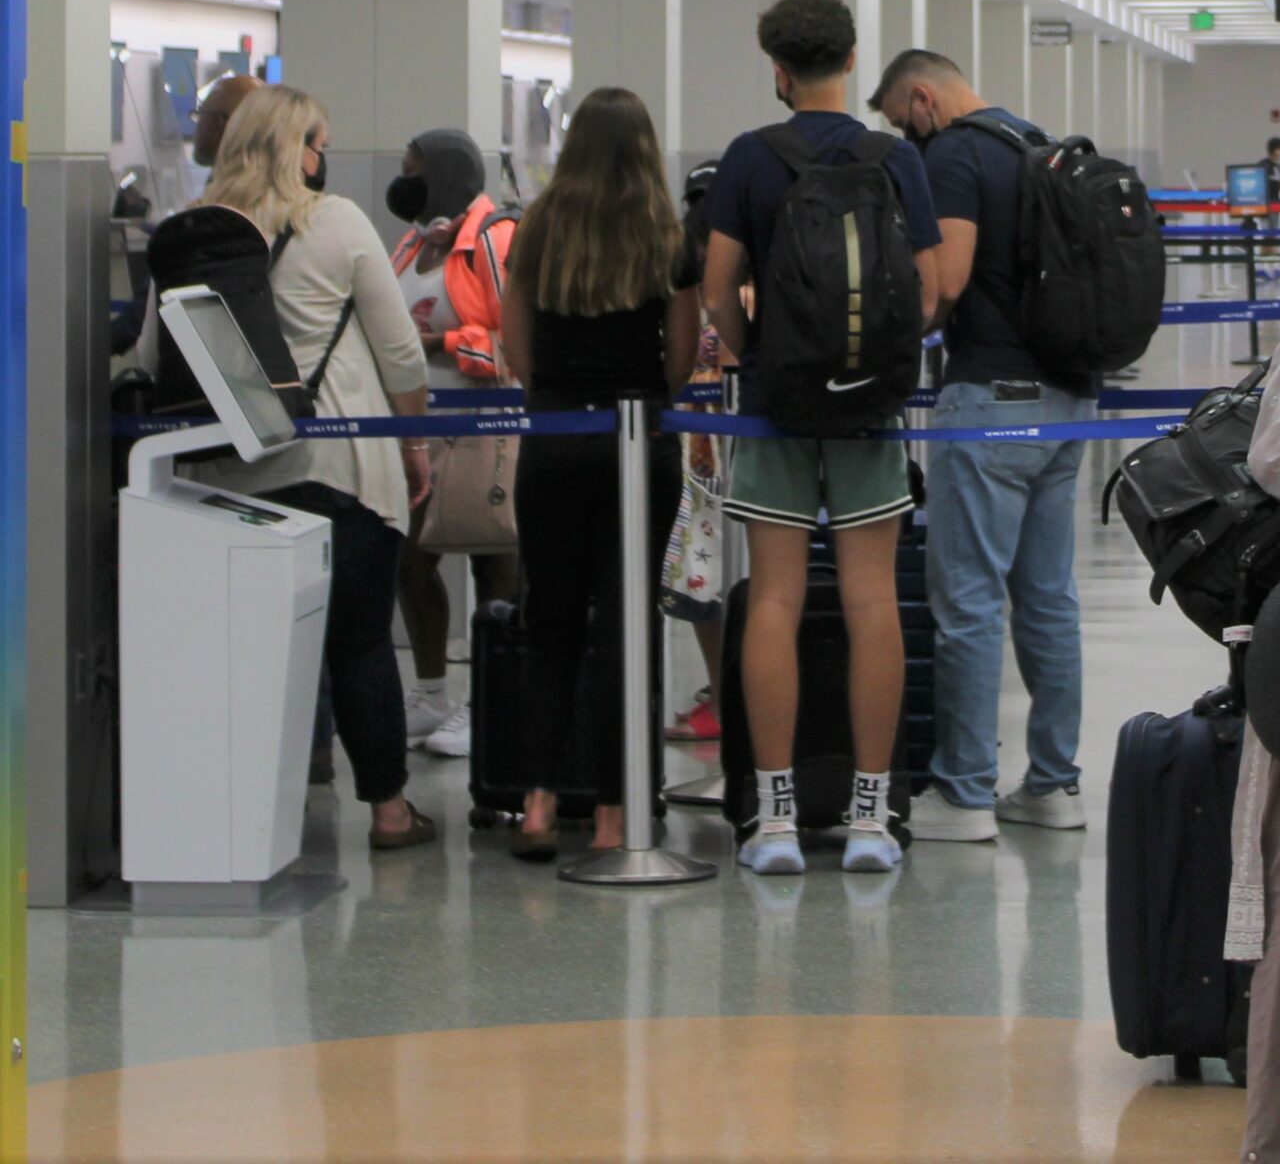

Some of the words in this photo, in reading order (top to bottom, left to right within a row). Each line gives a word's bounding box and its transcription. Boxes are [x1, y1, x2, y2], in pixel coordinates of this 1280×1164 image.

[692, 388, 722, 397] UNITE
[907, 393, 936, 402] ITED
[305, 424, 347, 433] UNITED
[477, 420, 518, 429] UNITED
[1155, 423, 1184, 432] UNIT
[984, 429, 1026, 437] UNITED
